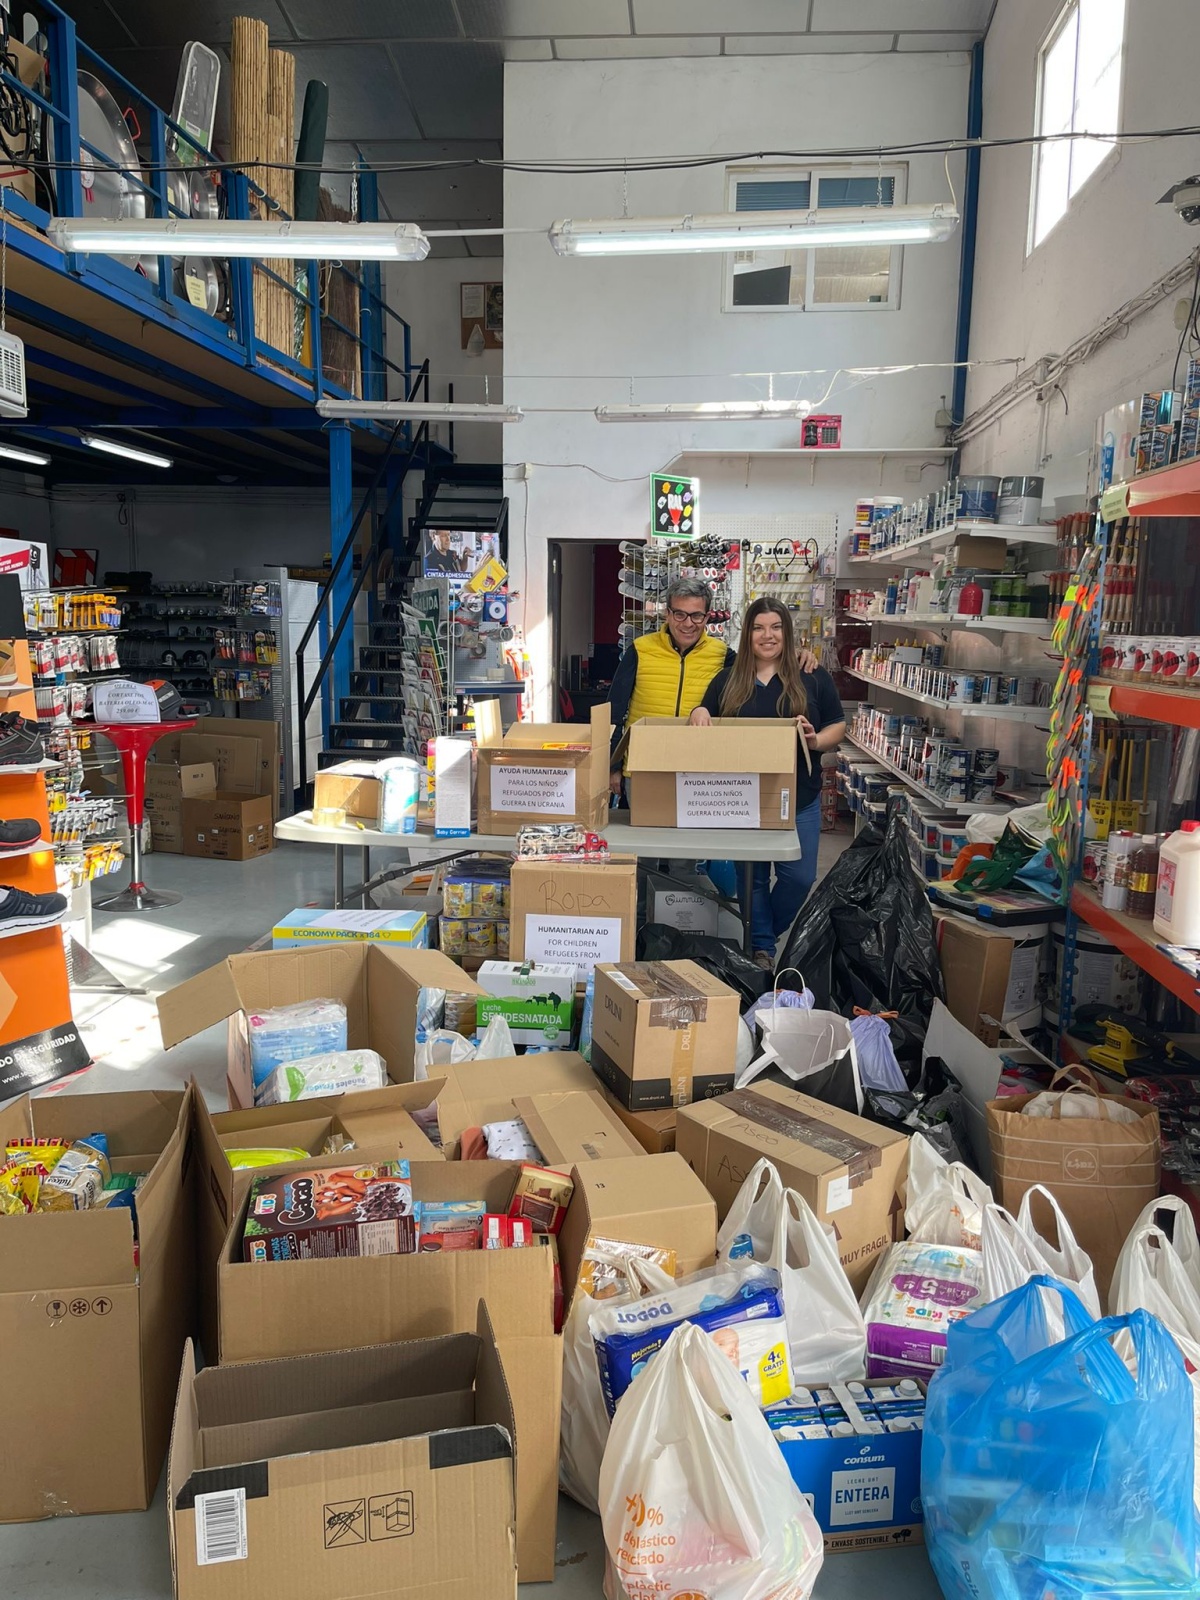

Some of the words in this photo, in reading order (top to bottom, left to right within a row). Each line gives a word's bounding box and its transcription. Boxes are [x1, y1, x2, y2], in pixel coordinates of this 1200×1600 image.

[765, 547, 791, 555] JMA
[723, 789, 743, 797] NIÑOS
[539, 880, 610, 916] Ropa
[538, 926, 594, 935] HUMANITARIAN
[544, 950, 579, 958] REFUGEES
[482, 1004, 502, 1012] Leche
[604, 994, 622, 1022] DRUNI
[28, 1034, 76, 1055] SEGURIDAD
[335, 1078, 366, 1089] Pañales
[730, 1122, 779, 1145] Aseo
[261, 1193, 276, 1213] KIDS
[277, 1178, 316, 1225] Cacao
[252, 1240, 267, 1262] IDS
[840, 1250, 860, 1266] MUY
[860, 1235, 889, 1257] FRAGIL
[921, 1279, 938, 1295] 5
[617, 1302, 674, 1323] DODOT
[906, 1306, 943, 1319] KIDS
[763, 1360, 785, 1373] GRATIS
[844, 1454, 885, 1465] consum
[835, 1486, 890, 1504] ENTERA
[831, 1537, 853, 1548] ENVASE
[855, 1534, 889, 1546] SOSTENIBLE
